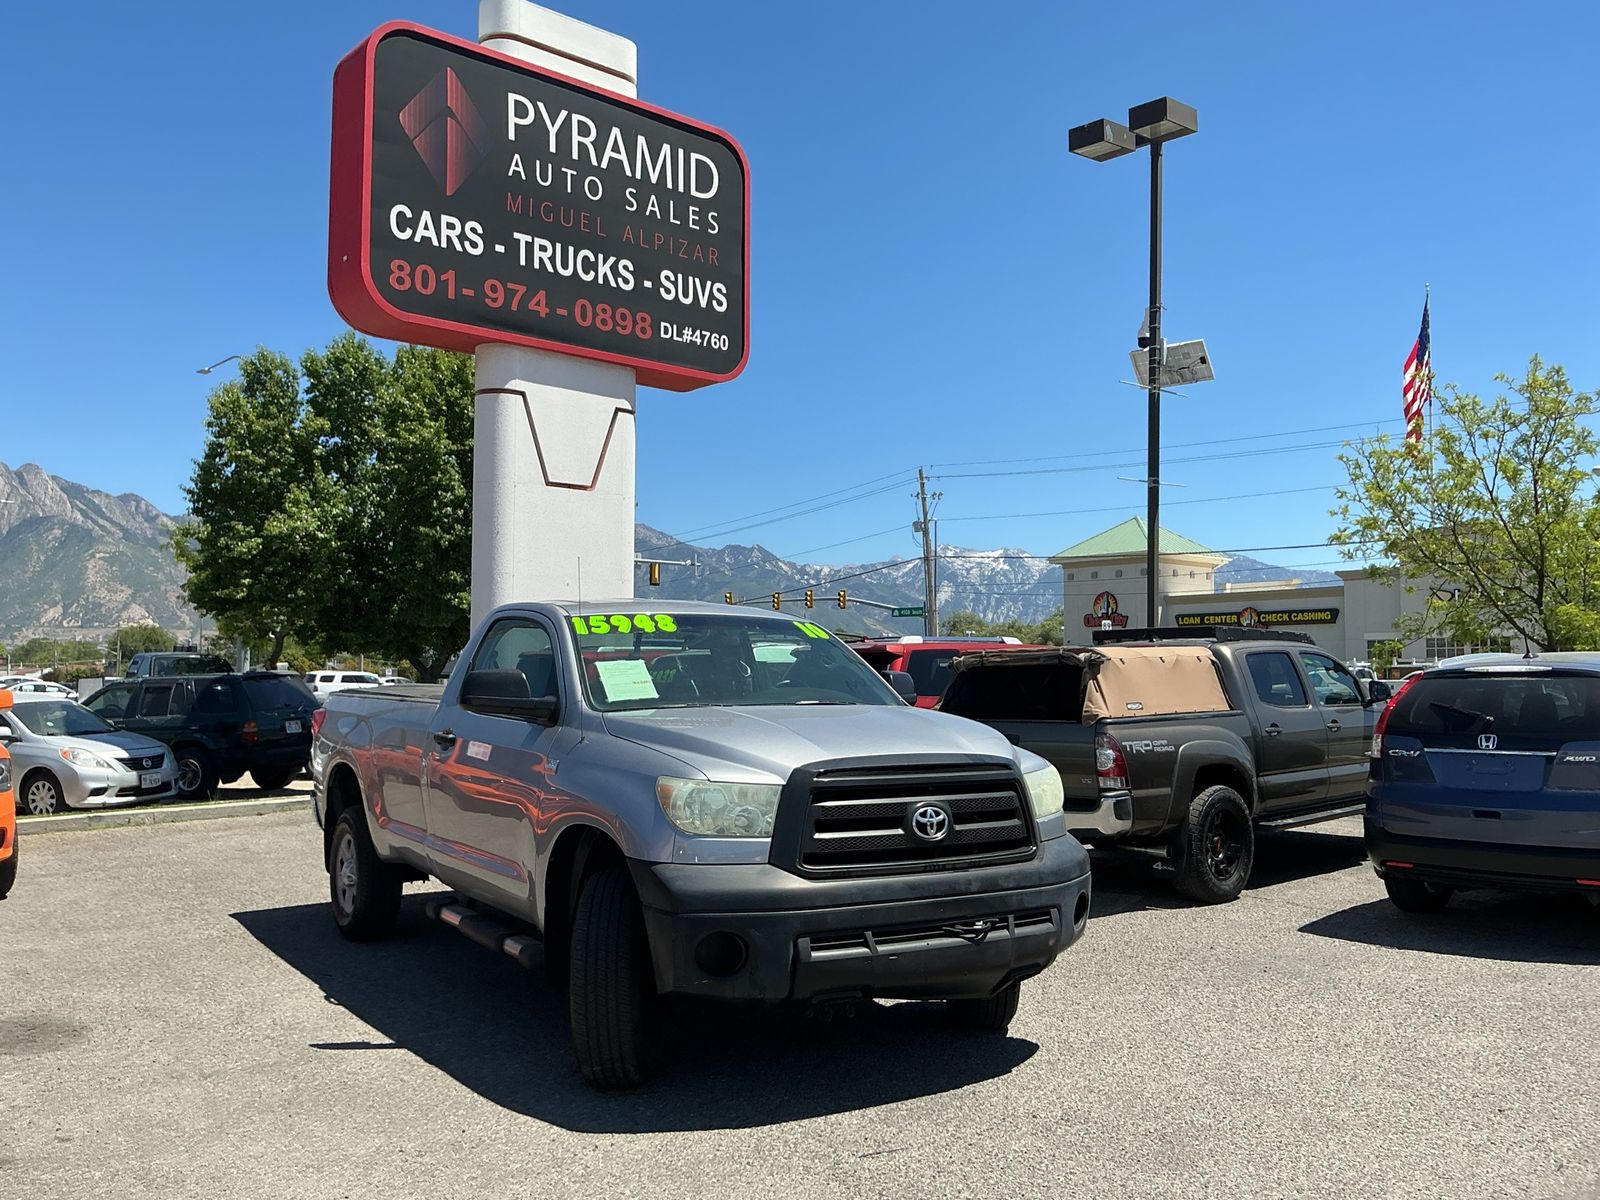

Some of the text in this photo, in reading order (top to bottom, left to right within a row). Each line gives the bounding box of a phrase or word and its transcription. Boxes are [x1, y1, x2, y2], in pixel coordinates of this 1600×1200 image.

[507, 92, 719, 199] PYRAMID
[508, 153, 719, 235] AUTO SALES
[505, 192, 719, 266] MIGUEL ALPIZAR
[389, 204, 485, 256] CARS
[513, 232, 635, 291] TRUCKS
[659, 269, 728, 313] SUVS
[659, 321, 729, 352] DL#4760
[571, 614, 677, 635] 15948
[1102, 622, 1111, 630] 89
[1178, 611, 1331, 625] LOAN CENTER CHECK CASHING
[1121, 740, 1153, 754] TRD
